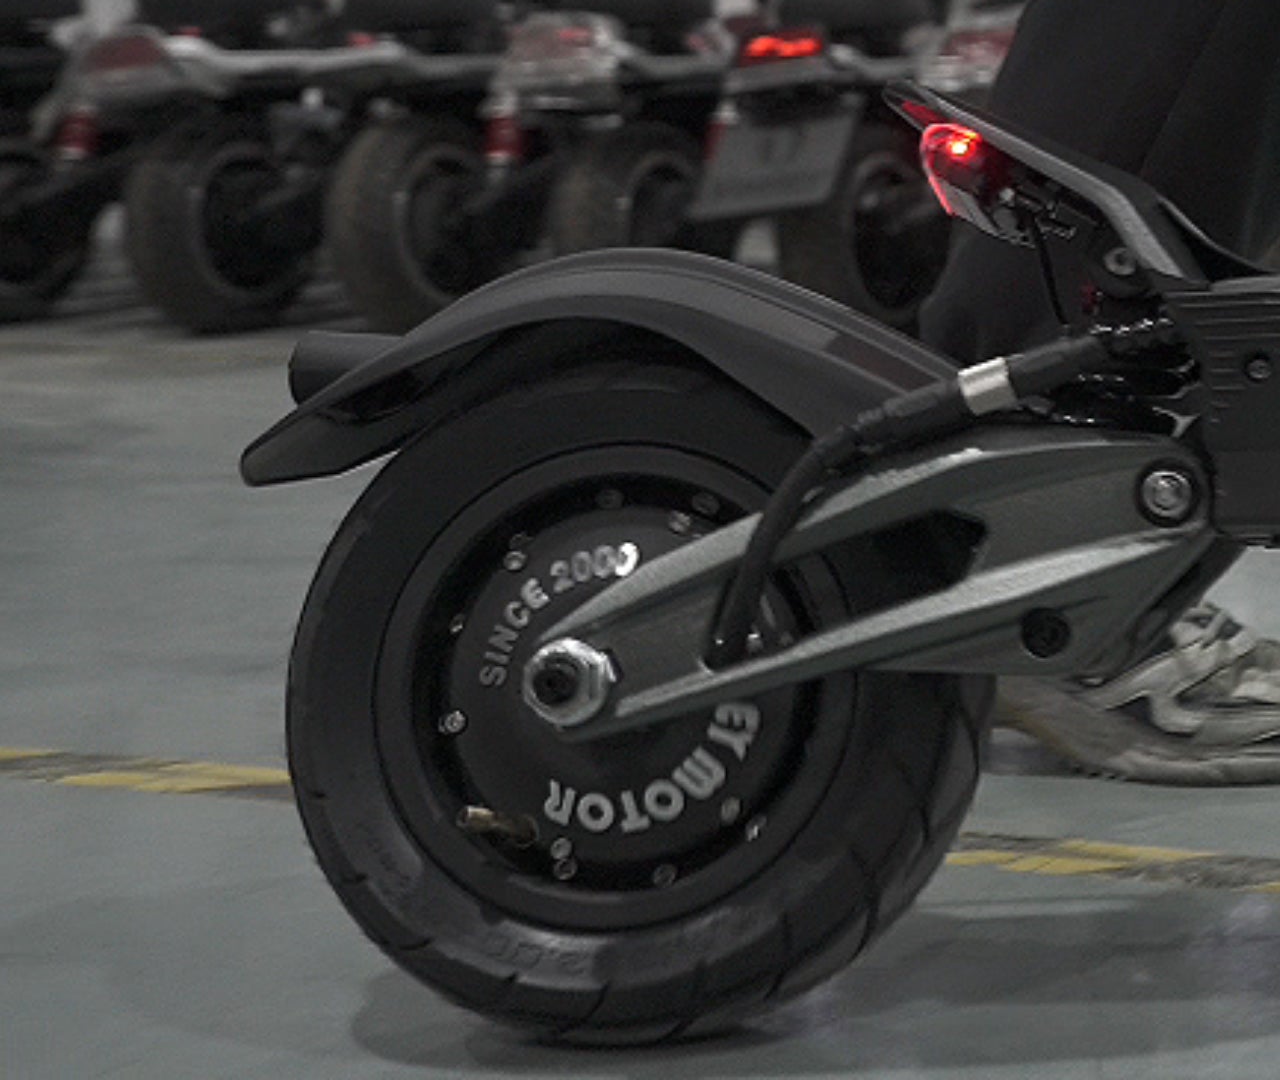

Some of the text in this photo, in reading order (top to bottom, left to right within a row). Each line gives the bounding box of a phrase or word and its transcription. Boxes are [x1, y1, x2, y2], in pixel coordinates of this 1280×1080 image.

[479, 541, 640, 687] SINCE 2000
[543, 745, 727, 834] MOTOR
